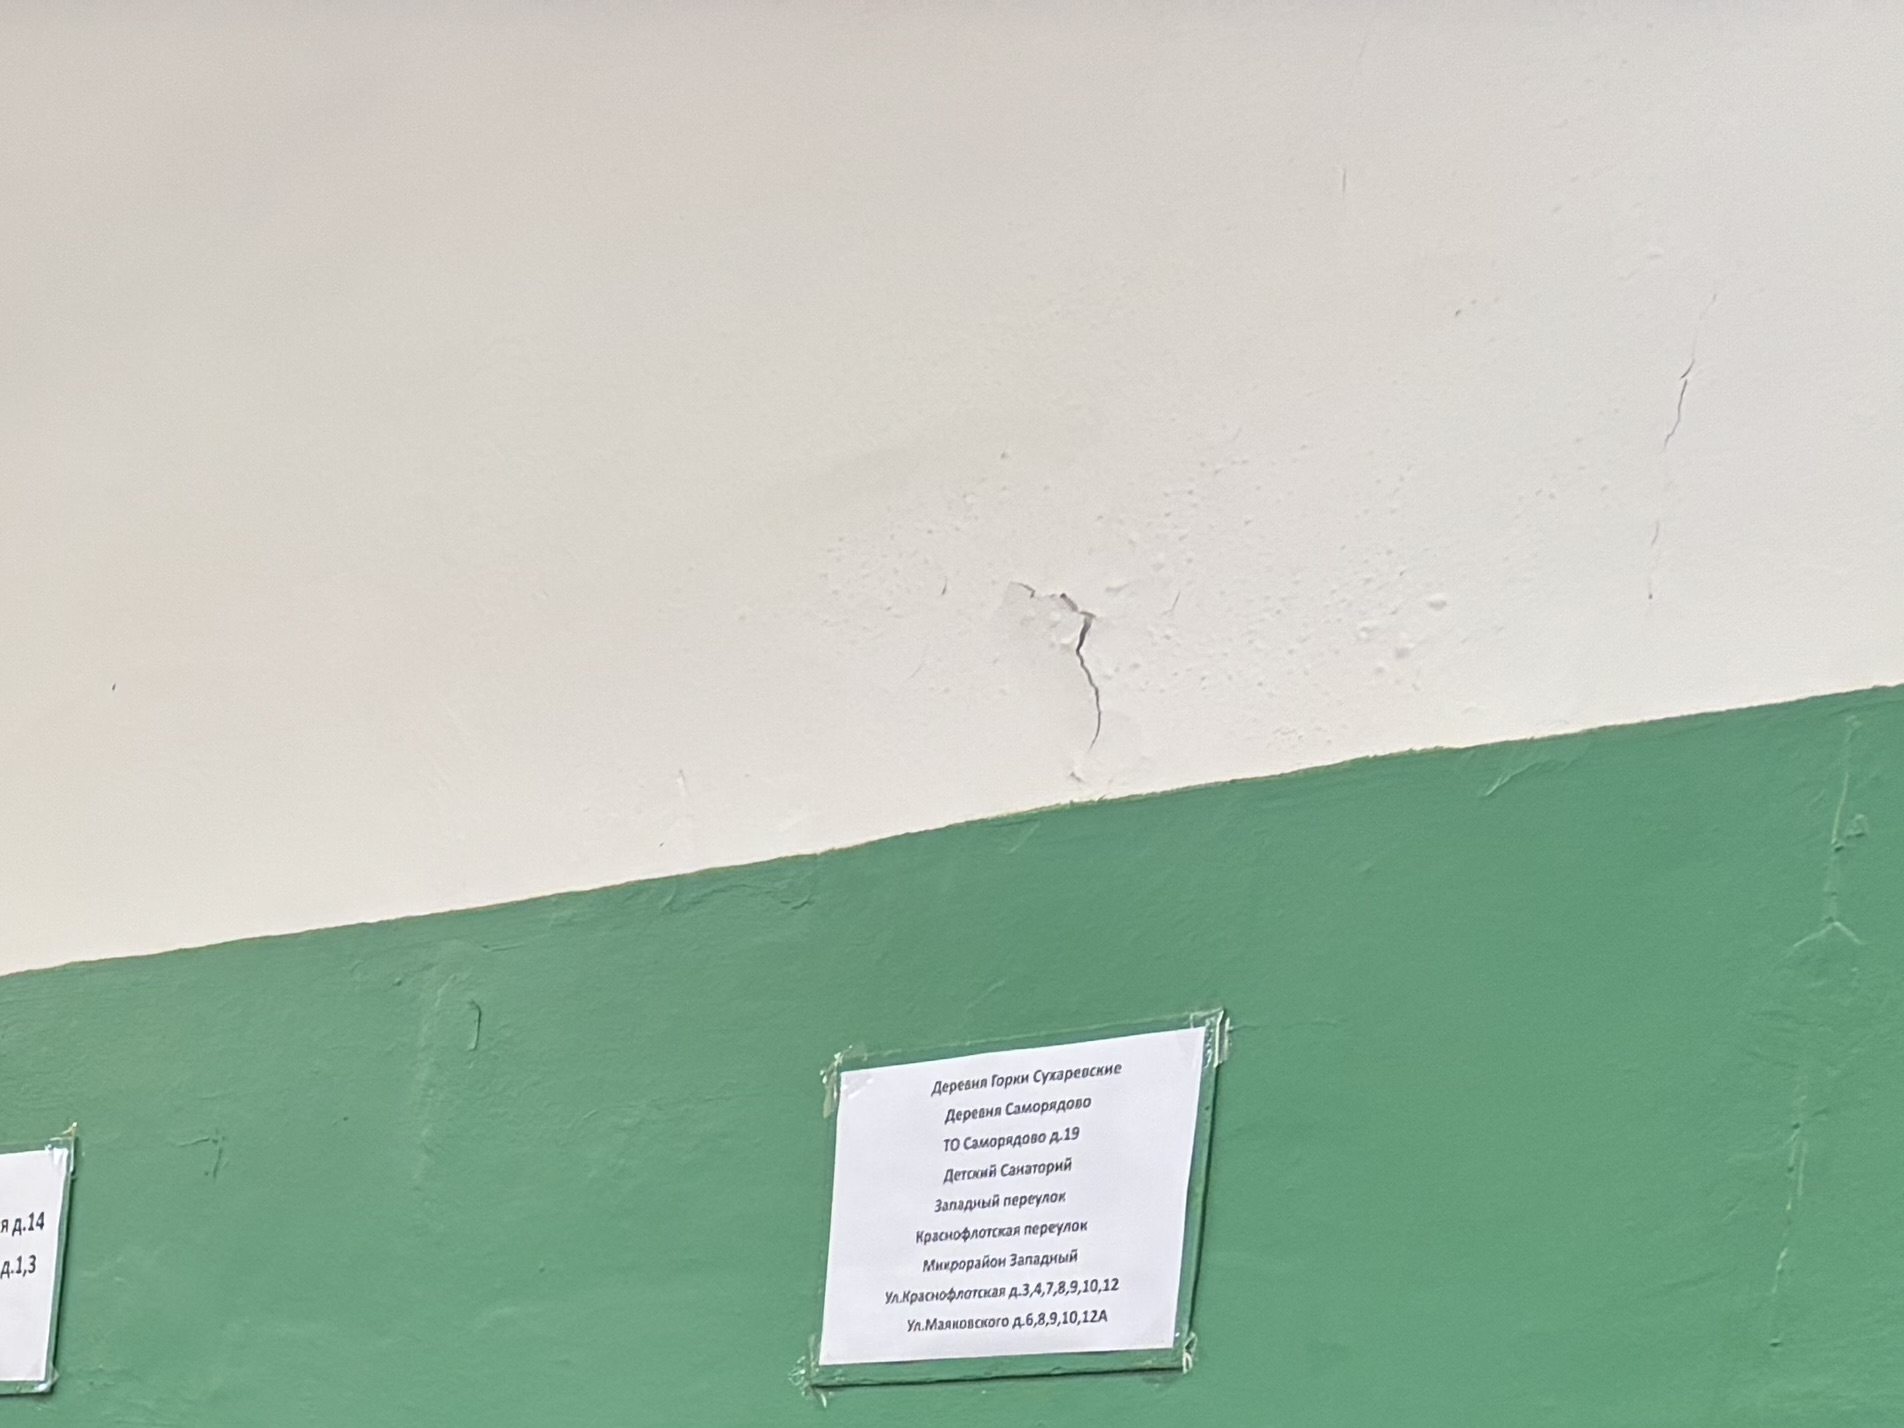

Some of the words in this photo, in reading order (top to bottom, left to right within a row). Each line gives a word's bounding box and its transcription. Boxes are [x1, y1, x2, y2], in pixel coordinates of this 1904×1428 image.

[930, 1078, 988, 1097] Деревня
[991, 1073, 1030, 1090] Горки
[1032, 1063, 1123, 1086] Сухаревские
[944, 1107, 1002, 1125] Деревня
[1005, 1097, 1092, 1119] Саморядово
[943, 1137, 961, 1152] ТО
[963, 1130, 1047, 1150] Саморядово
[1049, 1126, 1081, 1146] д.19
[942, 1164, 997, 1185] Детский
[1000, 1157, 1073, 1178] Санаторий
[934, 1193, 1001, 1213] Западный
[1003, 1190, 1067, 1210] переулок
[11, 1211, 46, 1237] д.14
[915, 1225, 1021, 1246] Краснофлотская
[1024, 1219, 1089, 1239] переулок
[0, 1254, 38, 1281] д.1,3
[922, 1254, 1007, 1274] Микрорайон
[1009, 1248, 1079, 1268] Западный
[884, 1285, 1006, 1306] Ул.Краснофлотская
[1008, 1277, 1120, 1300] д.3,4,7,8,9,10,12
[906, 1314, 1010, 1333] Ул.Маяковского
[1012, 1308, 1109, 1330] д.6,8,9,10,12А
